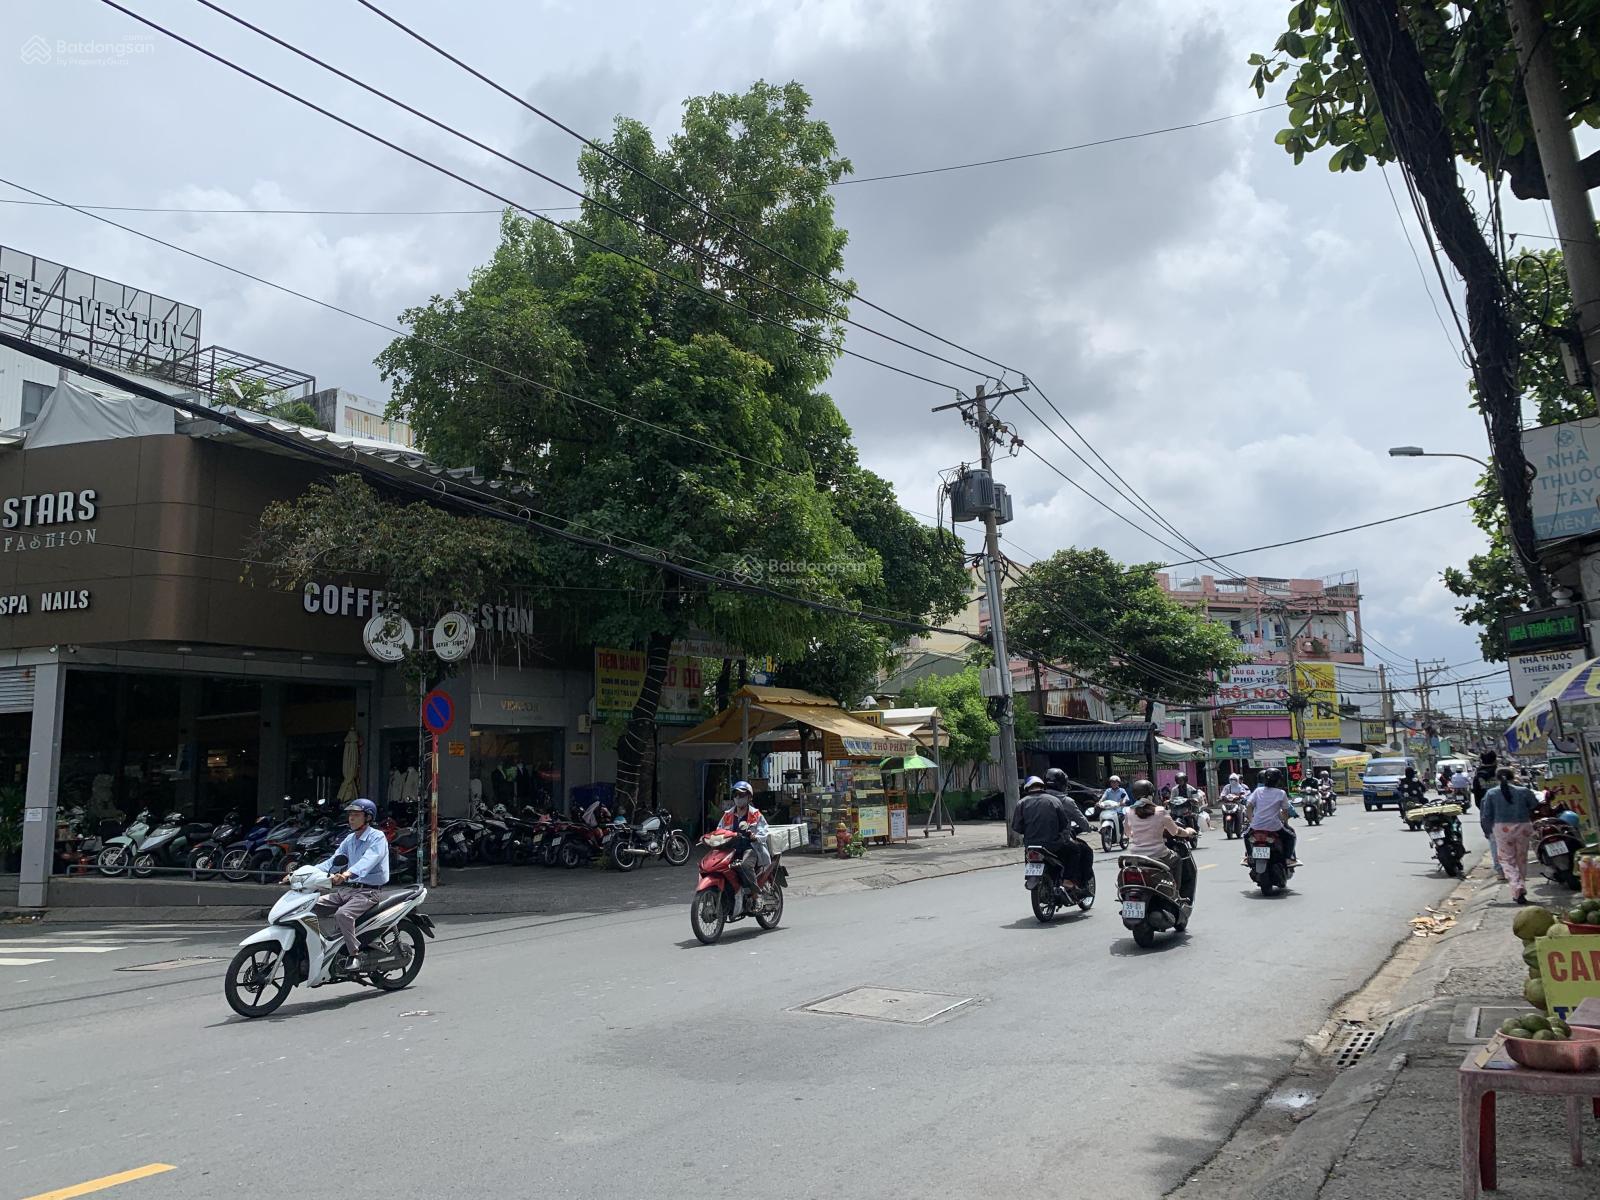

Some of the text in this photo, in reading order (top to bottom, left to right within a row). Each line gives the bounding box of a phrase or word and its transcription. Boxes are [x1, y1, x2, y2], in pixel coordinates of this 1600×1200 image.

[80, 295, 183, 350] VESTON
[2, 489, 96, 529] STARS
[3, 528, 97, 552] FASHION
[41, 589, 89, 612] NAILS
